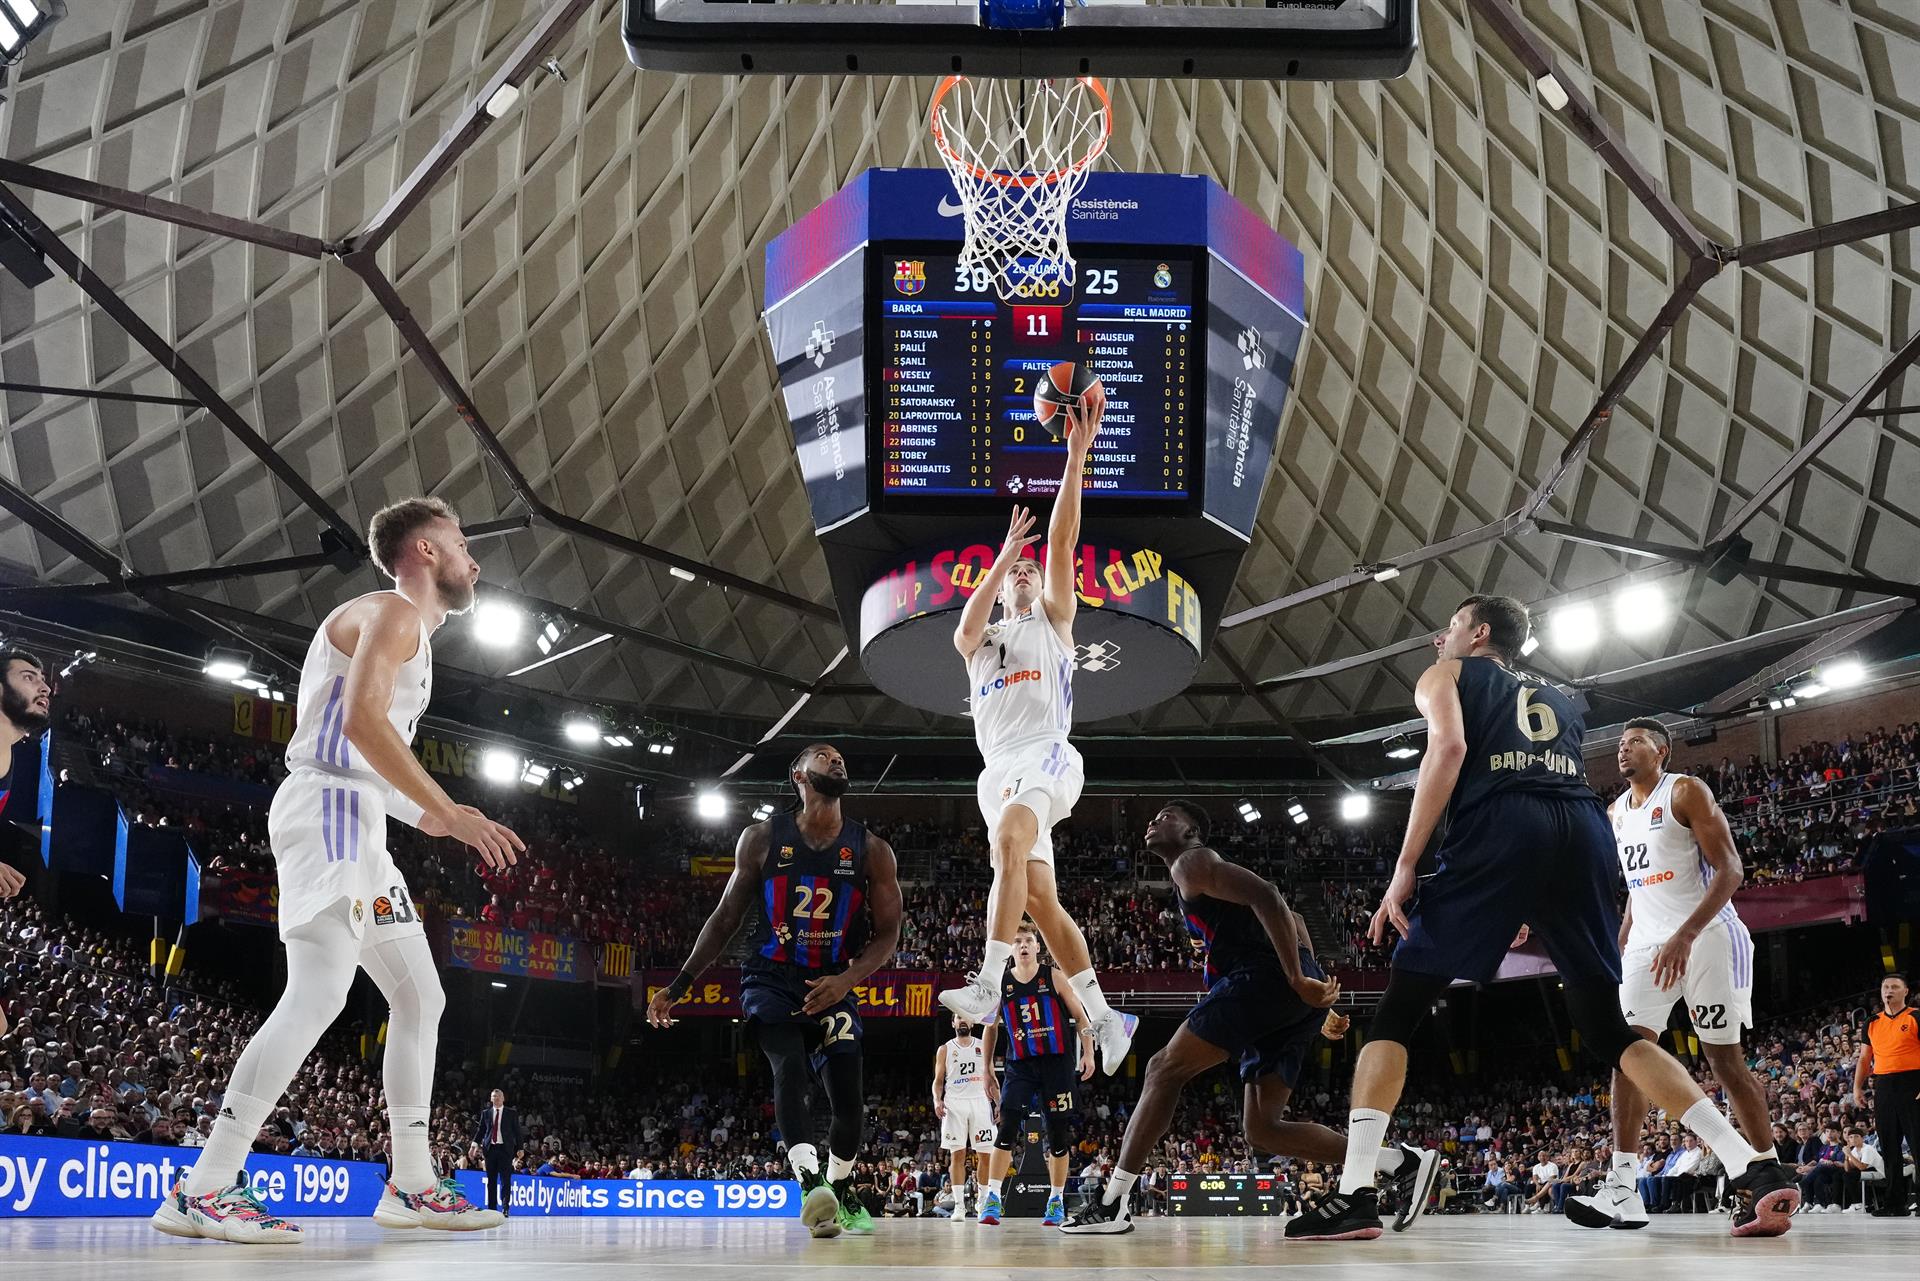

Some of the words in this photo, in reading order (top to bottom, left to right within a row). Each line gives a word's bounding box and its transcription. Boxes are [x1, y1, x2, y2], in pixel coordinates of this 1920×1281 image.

[1072, 198, 1138, 209] Assistència
[1072, 209, 1118, 220] Sanitària
[954, 267, 988, 292] 30
[1028, 264, 1062, 275] QUAR
[1086, 270, 1118, 294] 25
[892, 304, 922, 314] BARÇA
[1125, 308, 1147, 317] REAL
[1150, 308, 1186, 318] MADRID
[1027, 315, 1048, 336] 11
[900, 342, 925, 352] PAULÍ
[1014, 378, 1024, 392] 2
[812, 382, 829, 456] Sanitària
[900, 412, 962, 420] LAPROVITTOLA
[1227, 376, 1246, 450] Sanitària
[824, 376, 846, 480] Assistència
[1014, 427, 1024, 442] 0
[1233, 382, 1257, 488] Assistència
[950, 564, 991, 589] CLA
[1104, 548, 1162, 596] CLAP
[980, 670, 1041, 697] UTOHERO
[1517, 686, 1560, 741] 6
[1014, 776, 1023, 795] 1
[1624, 842, 1650, 872] 22
[1628, 870, 1674, 889] UTOHERO
[793, 885, 833, 919] 22
[1020, 1002, 1040, 1022] 31
[1696, 1004, 1727, 1030] 22
[820, 1012, 854, 1046] 22
[960, 1062, 975, 1075] 23
[1057, 1092, 1073, 1112] 31
[979, 1129, 992, 1142] 23
[294, 1164, 349, 1203] 1999
[1200, 1181, 1225, 1190] 6:06
[538, 1180, 554, 1213] by
[556, 1180, 609, 1208] clients
[618, 1182, 704, 1209] since
[714, 1184, 787, 1209] 1999
